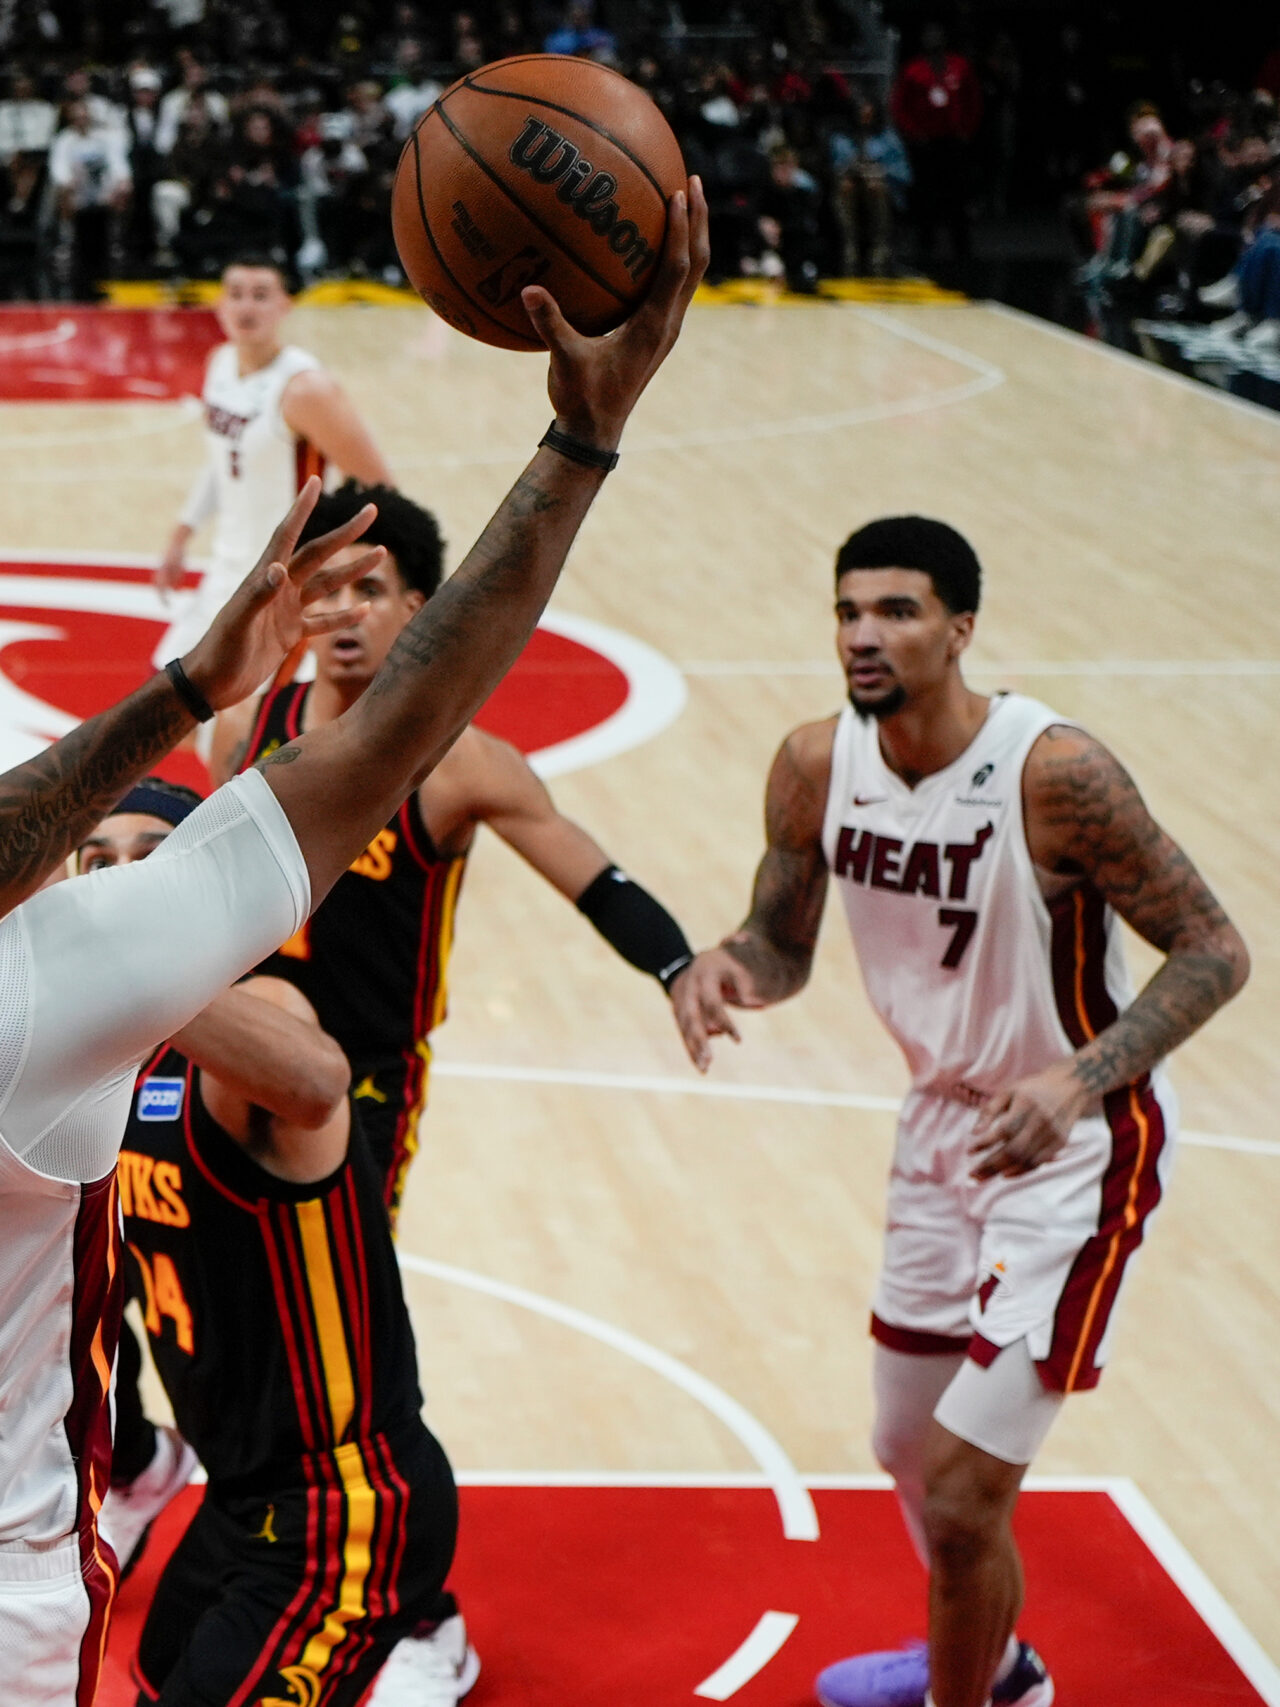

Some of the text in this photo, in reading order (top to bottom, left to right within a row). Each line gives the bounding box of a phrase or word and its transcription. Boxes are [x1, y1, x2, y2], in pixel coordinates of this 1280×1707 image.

[510, 115, 656, 283] Wilson
[834, 820, 994, 900] HEAT
[939, 909, 978, 970] 7
